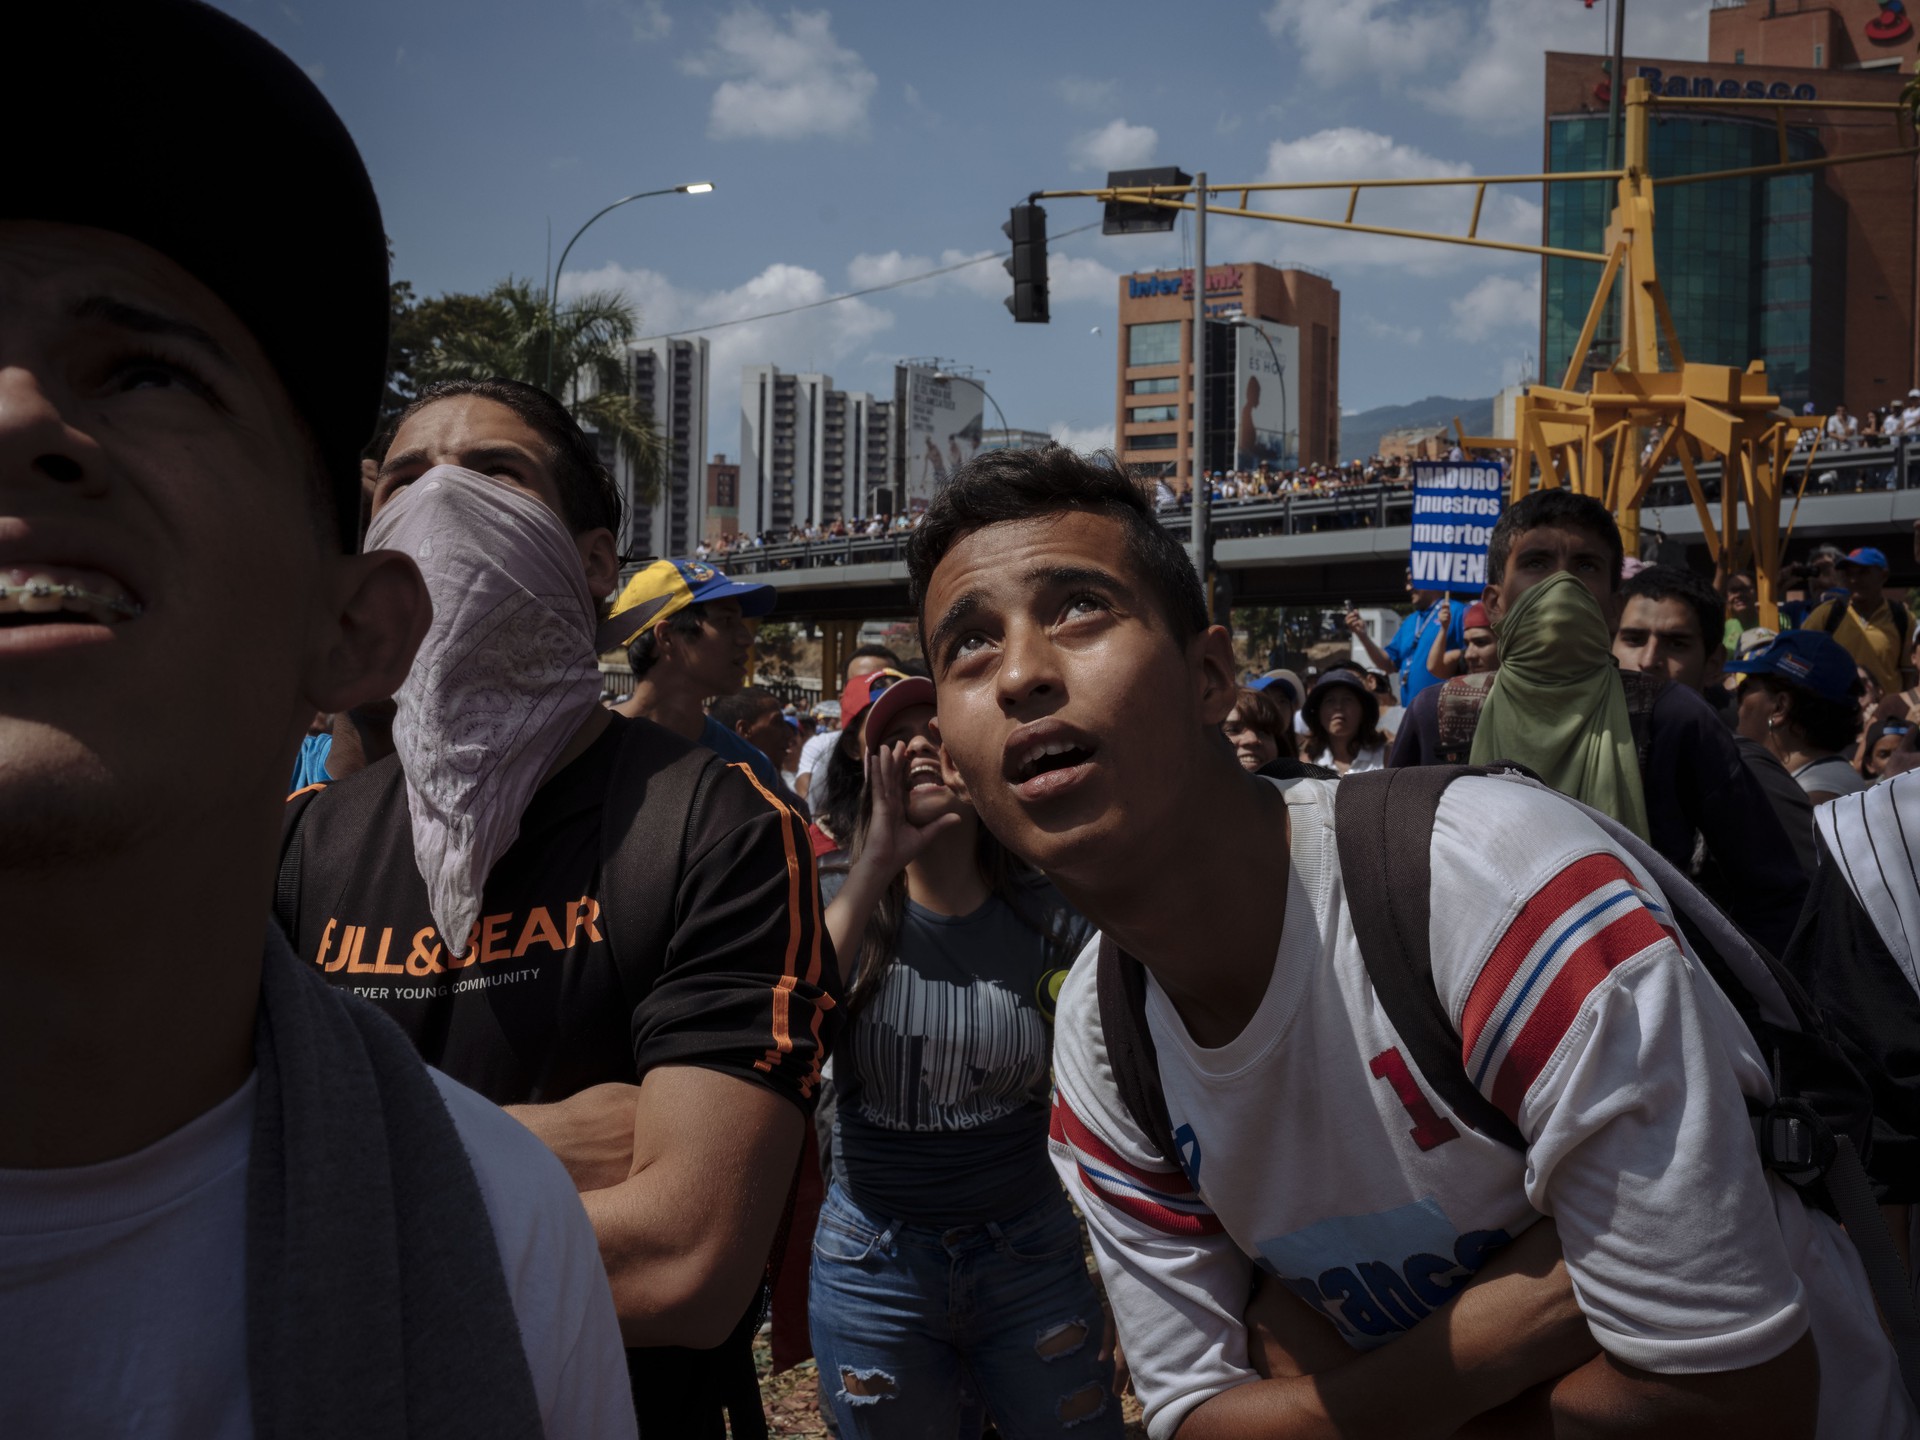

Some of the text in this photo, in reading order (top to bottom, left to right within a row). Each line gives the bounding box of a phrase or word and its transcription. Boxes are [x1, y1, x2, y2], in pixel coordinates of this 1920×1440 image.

[1636, 66, 1817, 101] Banesco
[1416, 467, 1500, 491] MADURO
[1412, 523, 1494, 546] muertos
[394, 986, 448, 1000] YOUNG
[451, 967, 541, 994] COMMUNITY
